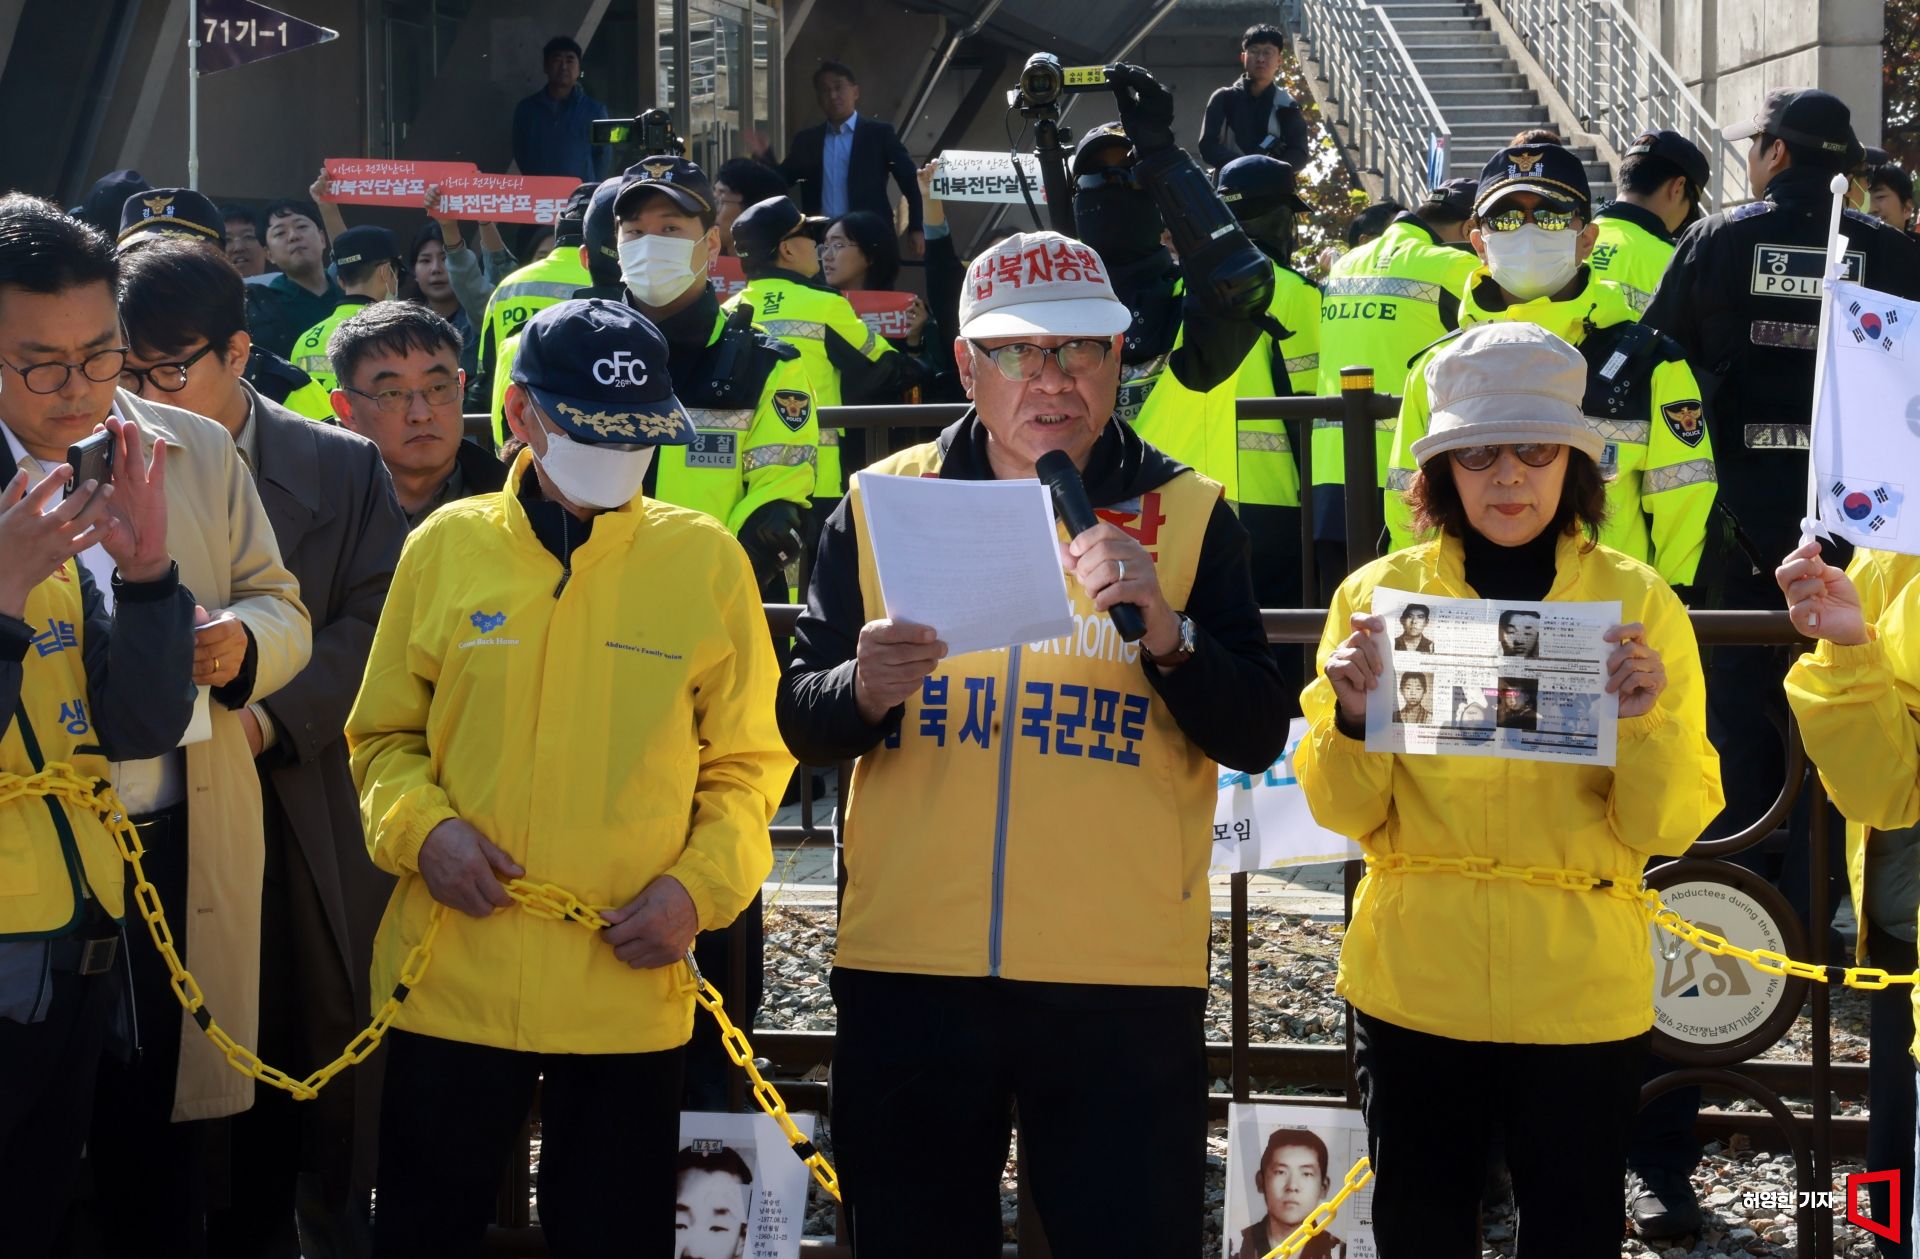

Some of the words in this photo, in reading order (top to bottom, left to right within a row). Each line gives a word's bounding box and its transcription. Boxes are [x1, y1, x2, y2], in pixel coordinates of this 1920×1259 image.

[203, 18, 287, 47] 71기-1
[1766, 276, 1817, 294] POLI
[592, 351, 648, 386] CFC
[690, 455, 732, 464] POLICE
[496, 637, 520, 645] Home
[641, 647, 663, 657] Family
[1021, 682, 1150, 767] 국군포로
[1671, 888, 1726, 900] Abductees
[1728, 896, 1759, 921] during
[1758, 919, 1771, 936] the
[1767, 978, 1779, 998] War
